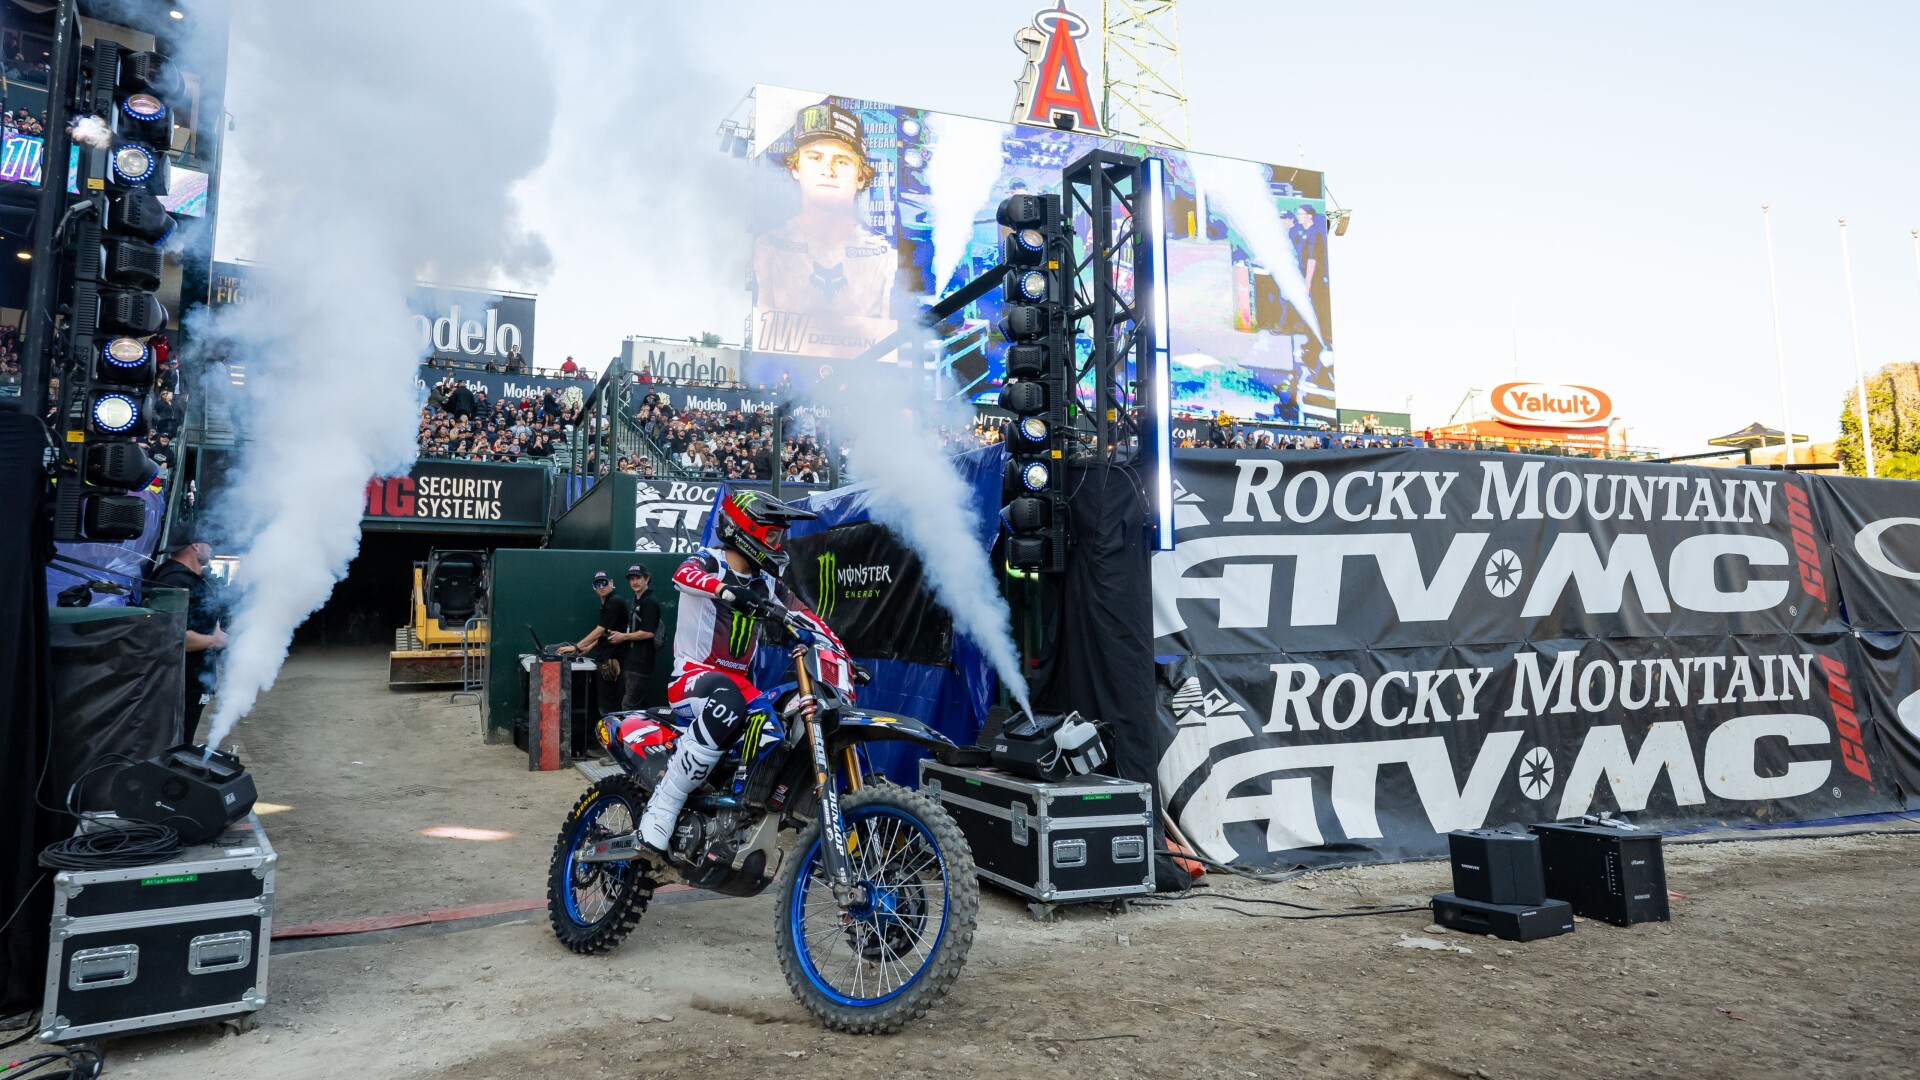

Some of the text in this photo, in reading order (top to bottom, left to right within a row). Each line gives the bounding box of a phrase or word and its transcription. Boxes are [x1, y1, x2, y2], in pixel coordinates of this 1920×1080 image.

[864, 123, 895, 134] HAIDEN
[411, 304, 522, 357] odelo
[649, 350, 727, 387] Modelo
[687, 395, 727, 412] Modelo
[1510, 391, 1595, 415] Yakult
[419, 476, 503, 499] SECURITY
[665, 482, 719, 502] ROC
[1223, 459, 1777, 524] ROCKY MOUNTAIN
[417, 498, 502, 520] SYSTEMS
[837, 564, 893, 587] MONSTER
[845, 590, 881, 599] ENERGY
[1262, 650, 1814, 733] ROCKY MOUNTAIN
[705, 698, 739, 728] FOX
[575, 791, 600, 818] DUNLOP
[828, 790, 845, 857] DUNLOP
